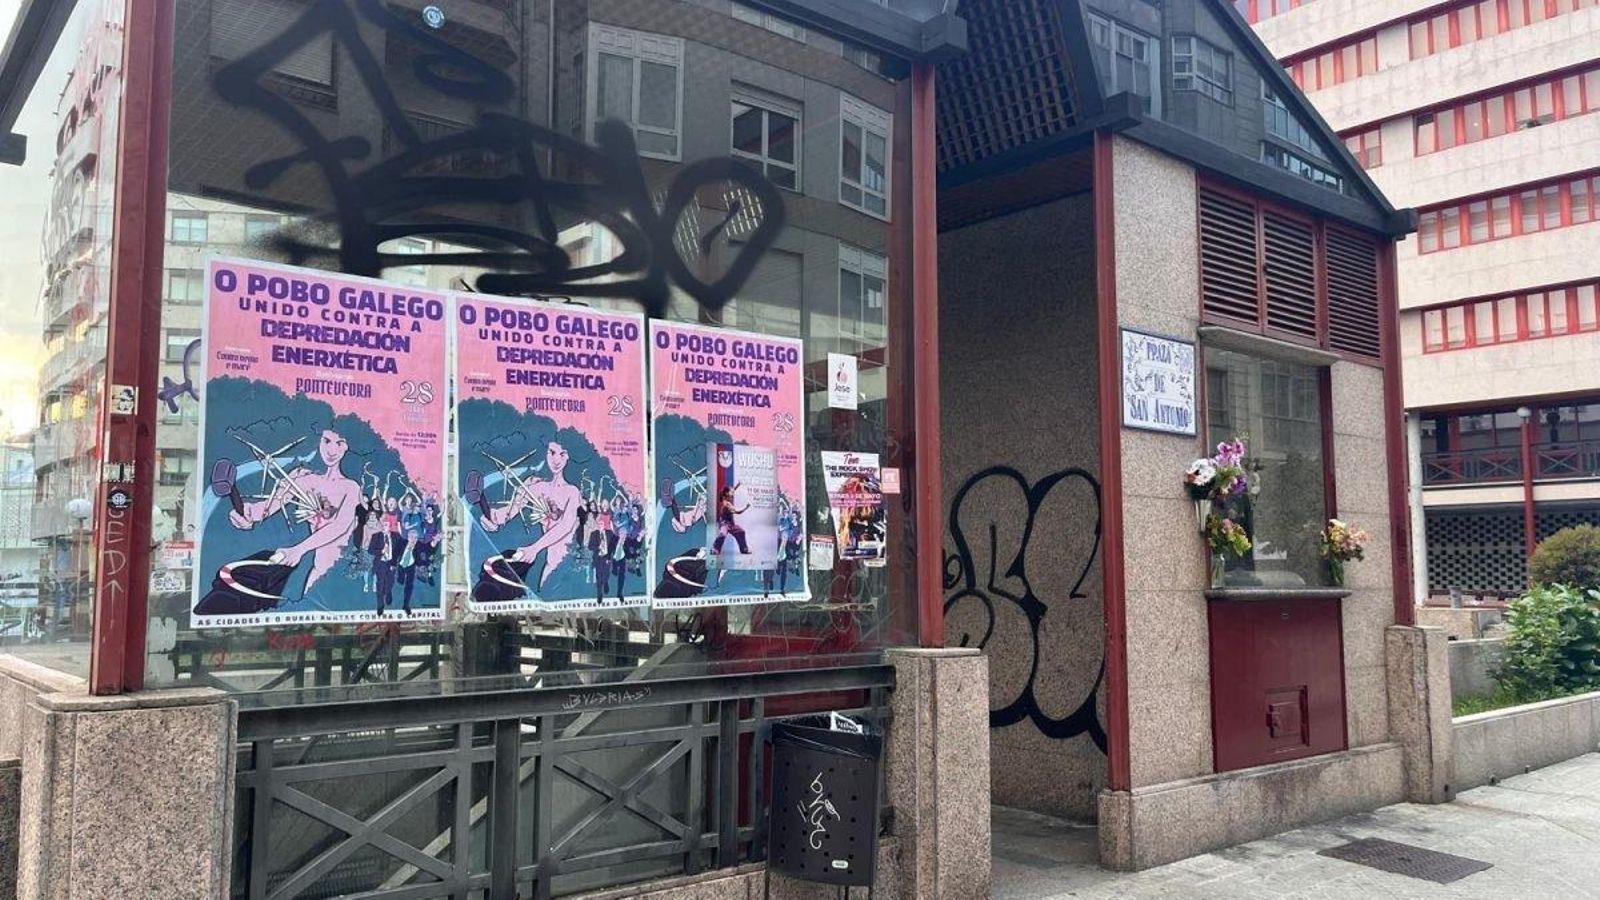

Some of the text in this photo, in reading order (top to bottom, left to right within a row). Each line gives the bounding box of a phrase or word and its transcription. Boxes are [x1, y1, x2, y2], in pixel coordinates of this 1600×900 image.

[215, 269, 443, 321] O POBO GALEGO
[238, 297, 422, 332] UNIDO CONTRA A
[459, 304, 639, 341] O POBO GALEGO
[260, 319, 411, 352] DEPREDACIÓN
[479, 328, 622, 352] UNIDO CONTRA A
[656, 331, 798, 364] O POBO GALEGO
[271, 345, 398, 374] ENERXÉTICA
[496, 346, 614, 371] DEPREDACIÓN
[671, 352, 785, 374] UNIDO CONTRA A
[506, 368, 605, 391] ENERXÉTICA
[685, 367, 778, 391] DEPREDACIÓN
[400, 380, 433, 405] 28
[692, 388, 771, 408] ENERXÉTICA
[607, 395, 635, 417] 28
[1130, 397, 1189, 428] SAN ANTONIO
[772, 412, 794, 432] 28
[483, 603, 517, 612] CIDADES
[197, 618, 210, 626] AS
[216, 616, 260, 626] CIDADES
[265, 616, 271, 624] E
[275, 615, 281, 623] O
[286, 614, 315, 622] RURAL
